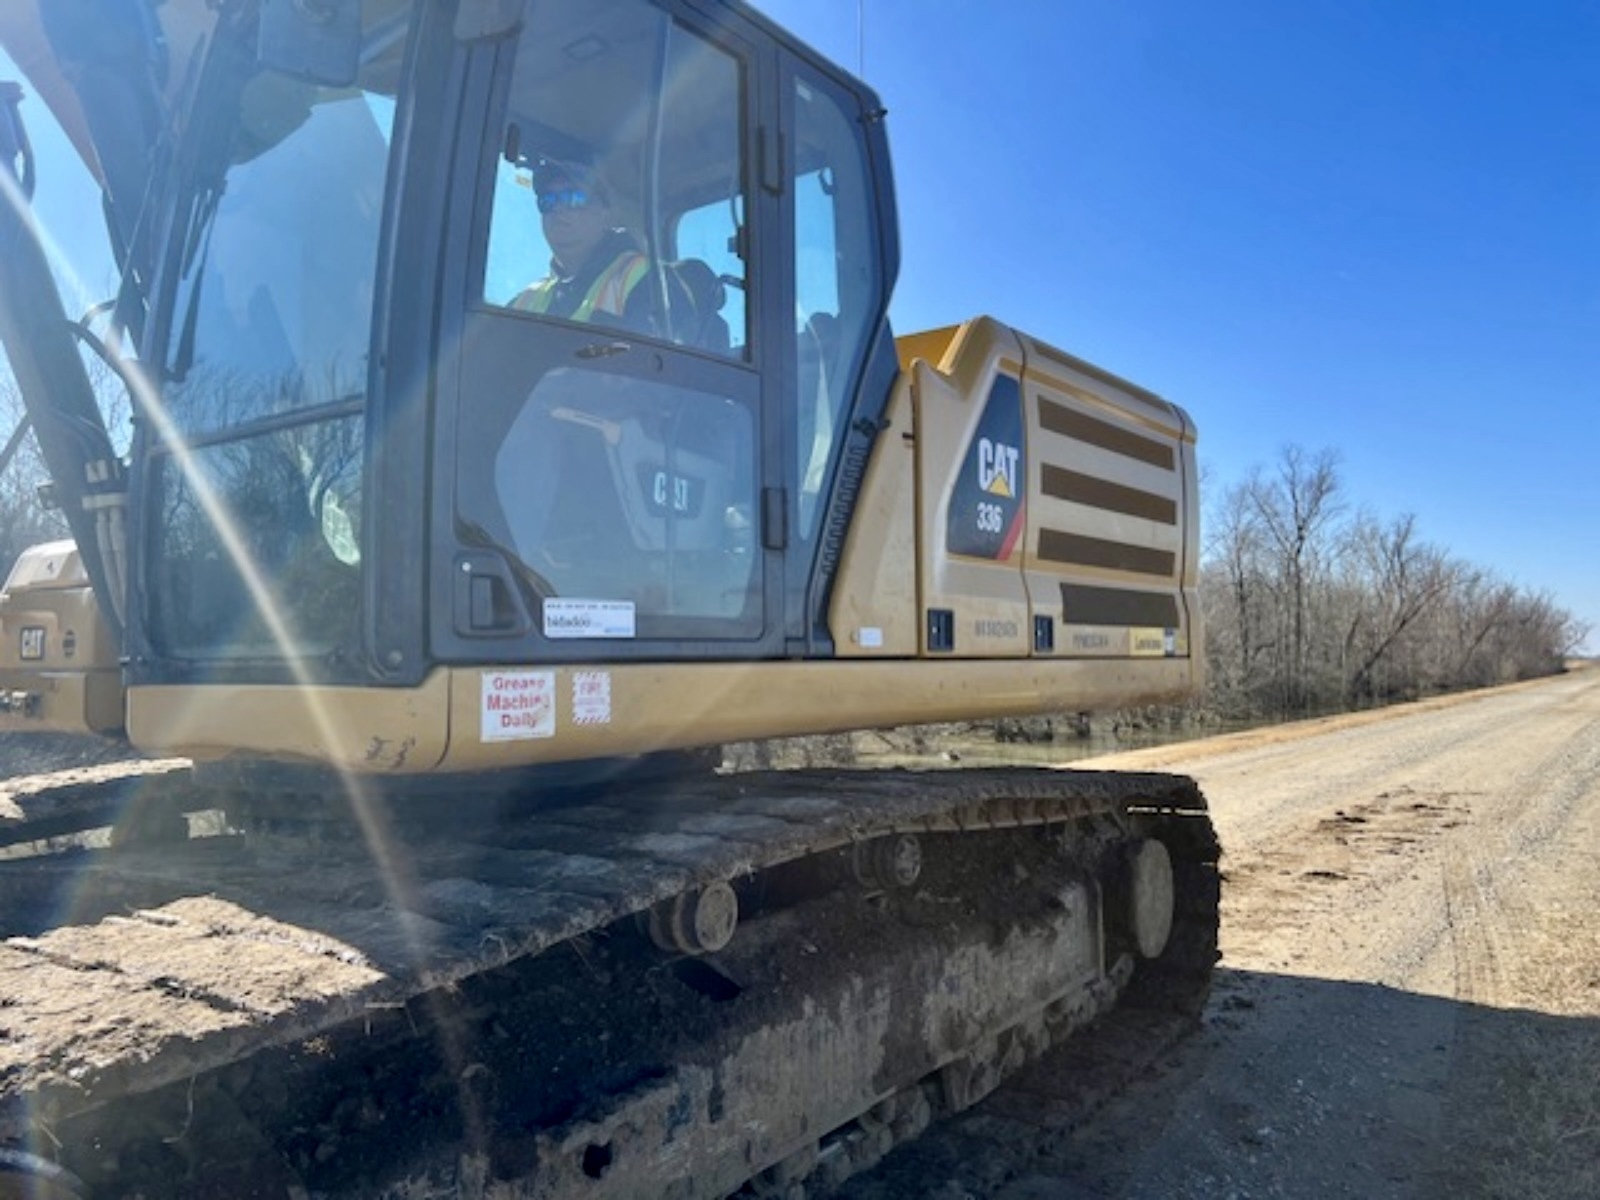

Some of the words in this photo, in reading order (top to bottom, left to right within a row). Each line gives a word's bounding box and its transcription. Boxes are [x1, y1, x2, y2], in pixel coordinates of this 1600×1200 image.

[979, 437, 1019, 499] CAT
[977, 501, 1003, 533] 336
[501, 713, 538, 728] Daily
